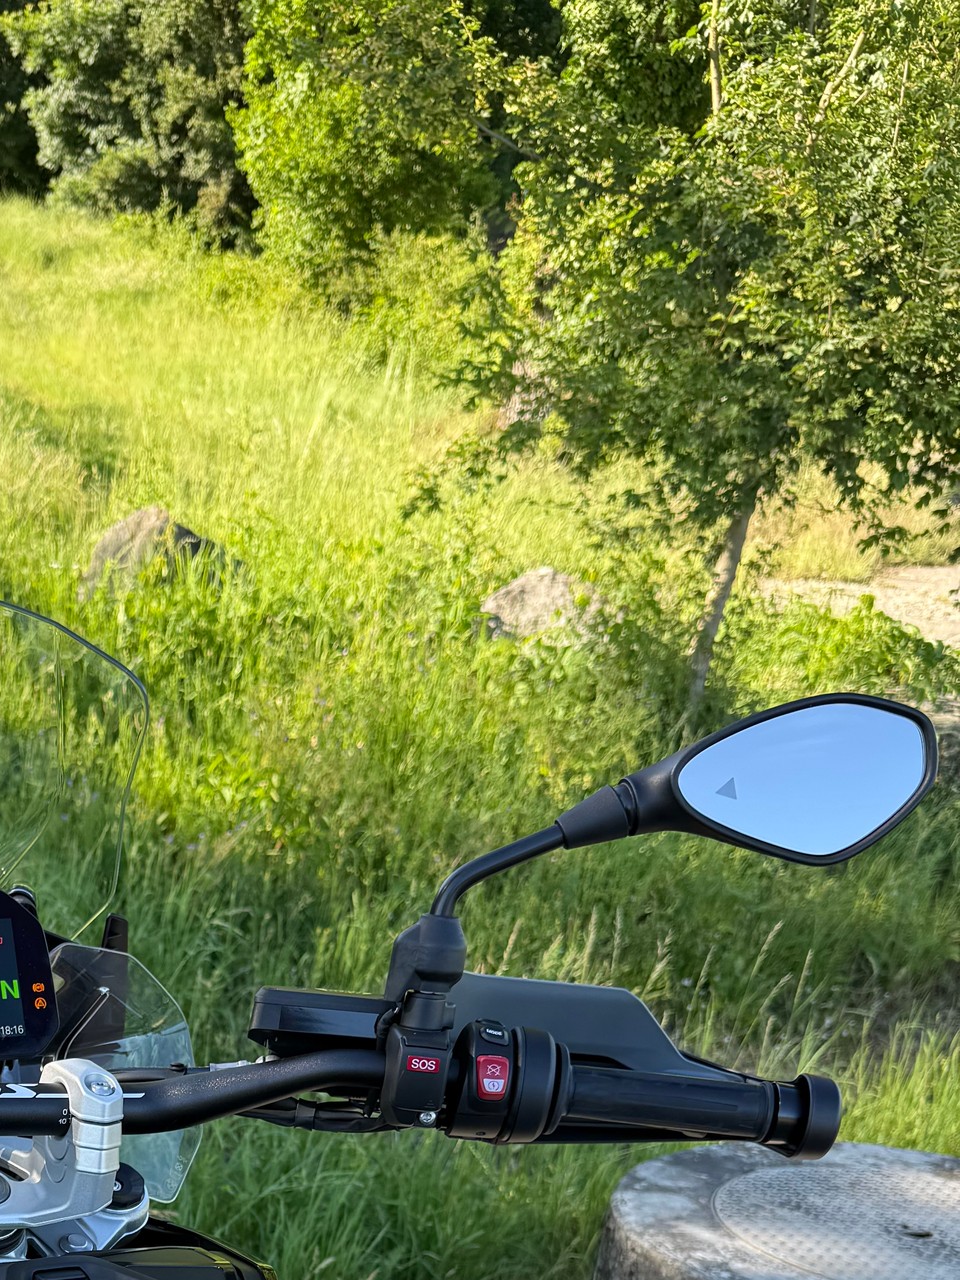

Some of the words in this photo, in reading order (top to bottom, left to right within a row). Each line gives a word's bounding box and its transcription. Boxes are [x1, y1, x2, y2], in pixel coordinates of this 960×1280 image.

[0, 979, 20, 1000] N
[0, 1025, 25, 1035] 18:16
[411, 1058, 436, 1071] SOS
[62, 1108, 68, 1116] 0
